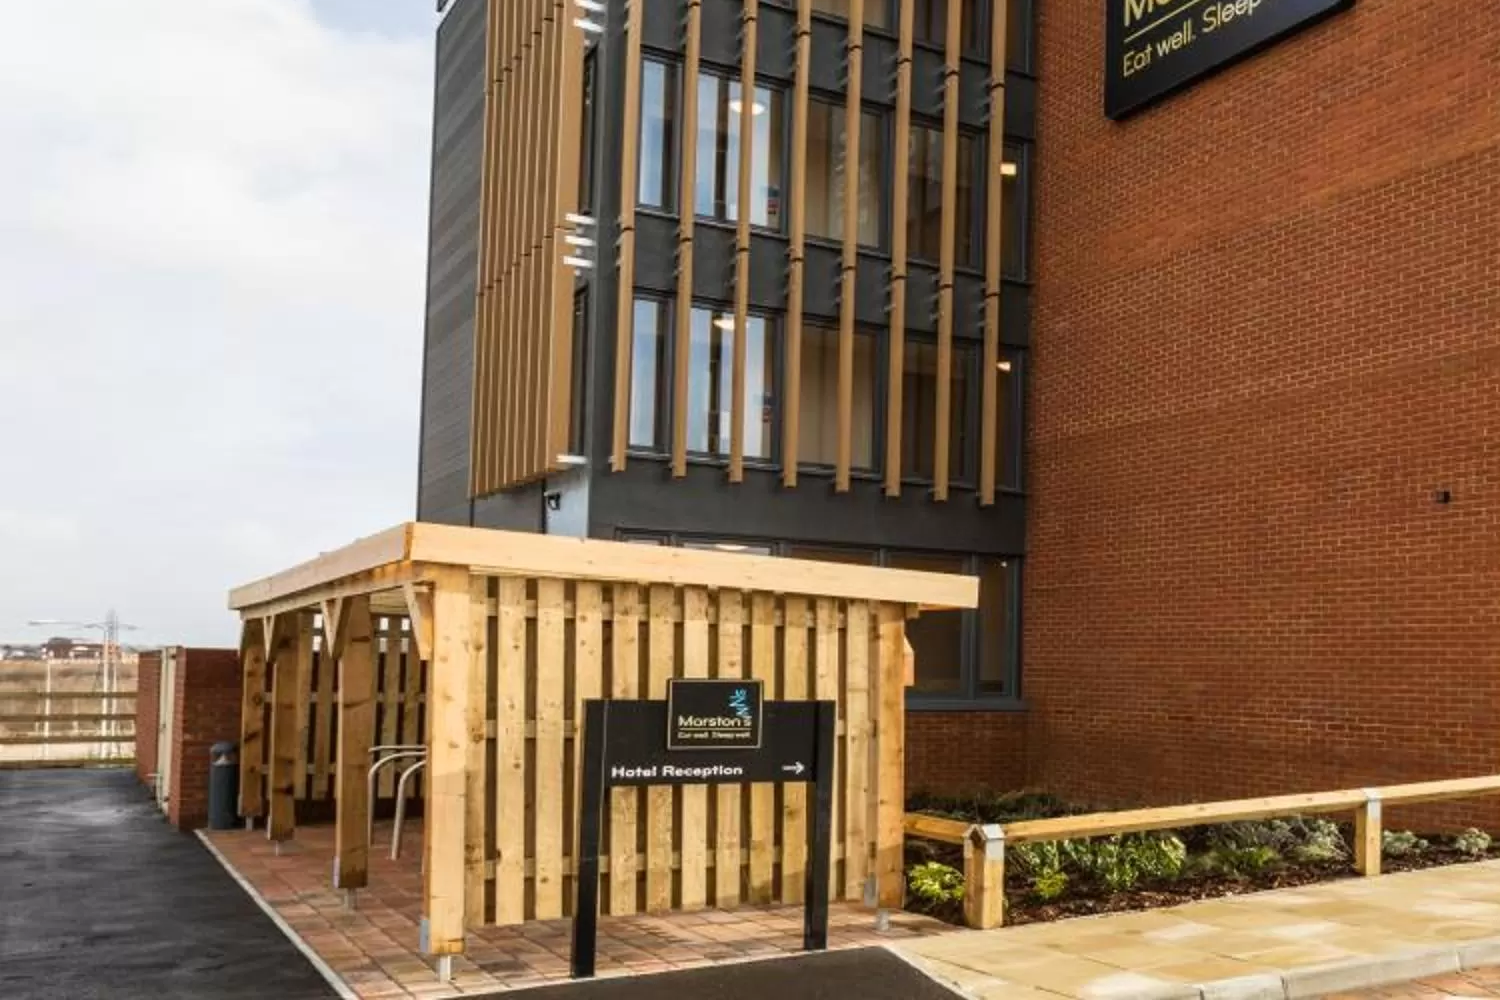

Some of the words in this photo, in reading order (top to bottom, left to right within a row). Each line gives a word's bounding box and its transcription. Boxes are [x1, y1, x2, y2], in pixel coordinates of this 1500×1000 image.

[1123, 43, 1153, 78] Eat
[1156, 18, 1197, 57] well.
[611, 766, 657, 778] Hotel
[662, 765, 743, 779] Reception
